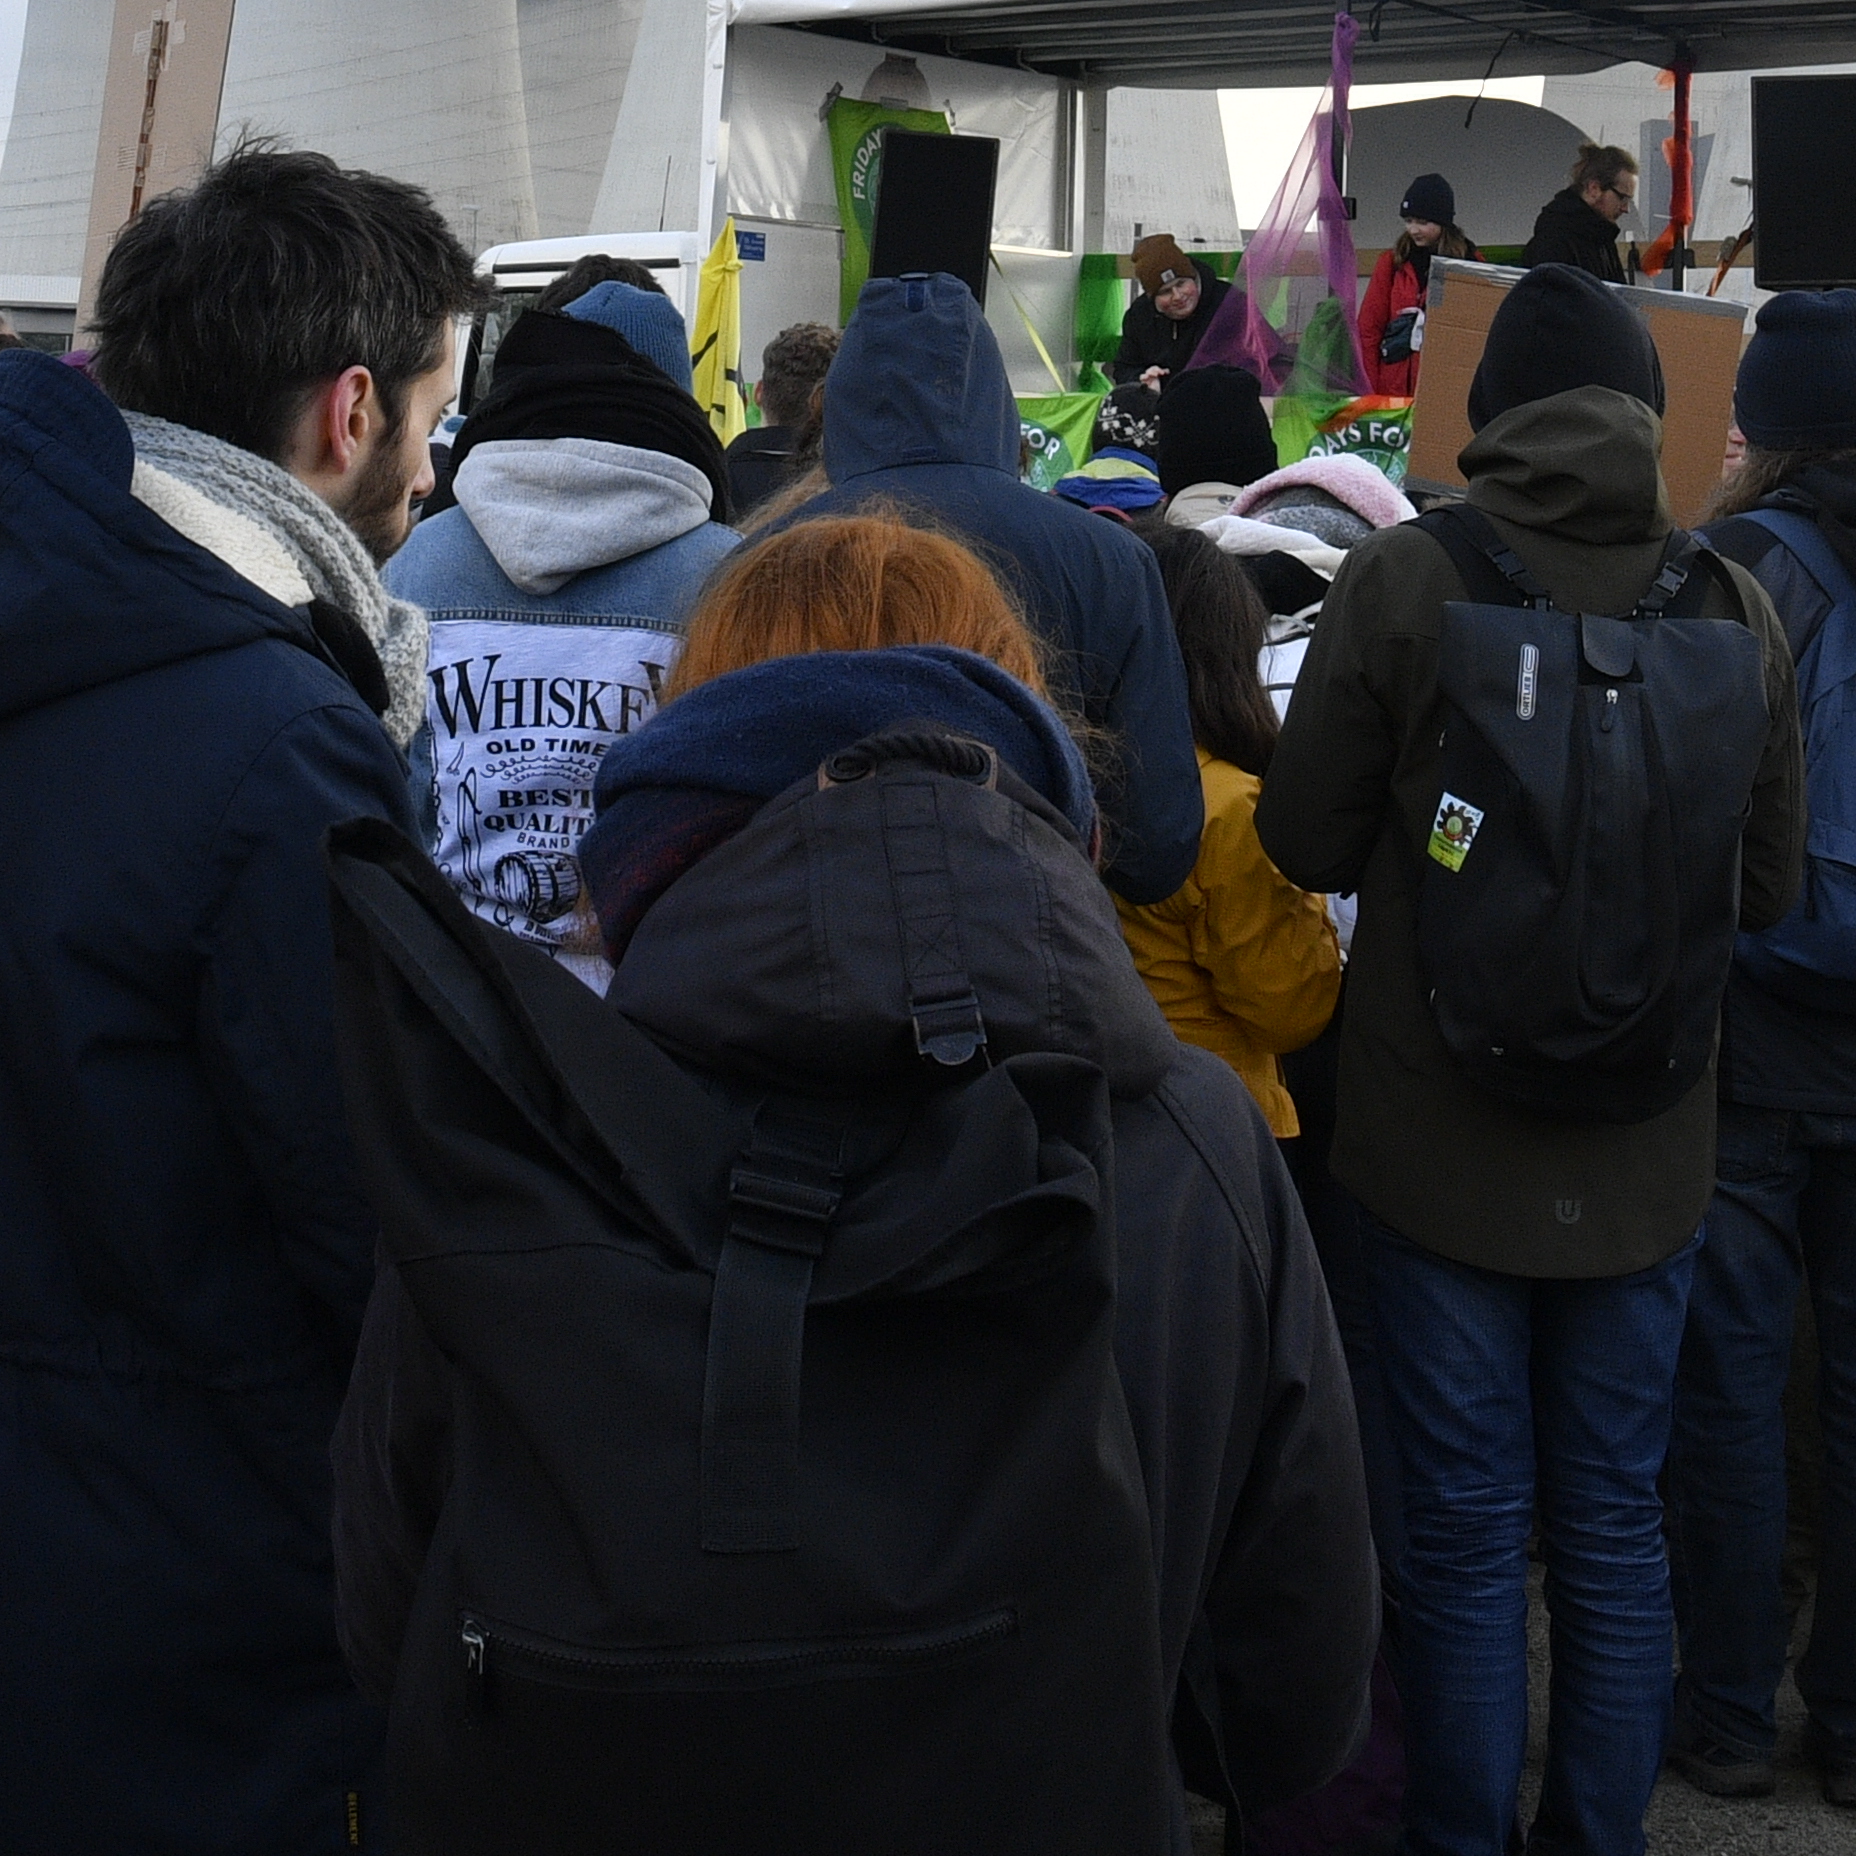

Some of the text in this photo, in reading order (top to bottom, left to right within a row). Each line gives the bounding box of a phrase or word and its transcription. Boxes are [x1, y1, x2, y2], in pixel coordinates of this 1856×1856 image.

[852, 127, 882, 200] FRIDAY
[486, 738, 610, 758] OLD TIME
[497, 788, 592, 810] BEST
[483, 812, 593, 837] QUALIT
[516, 832, 571, 850] BRAND
